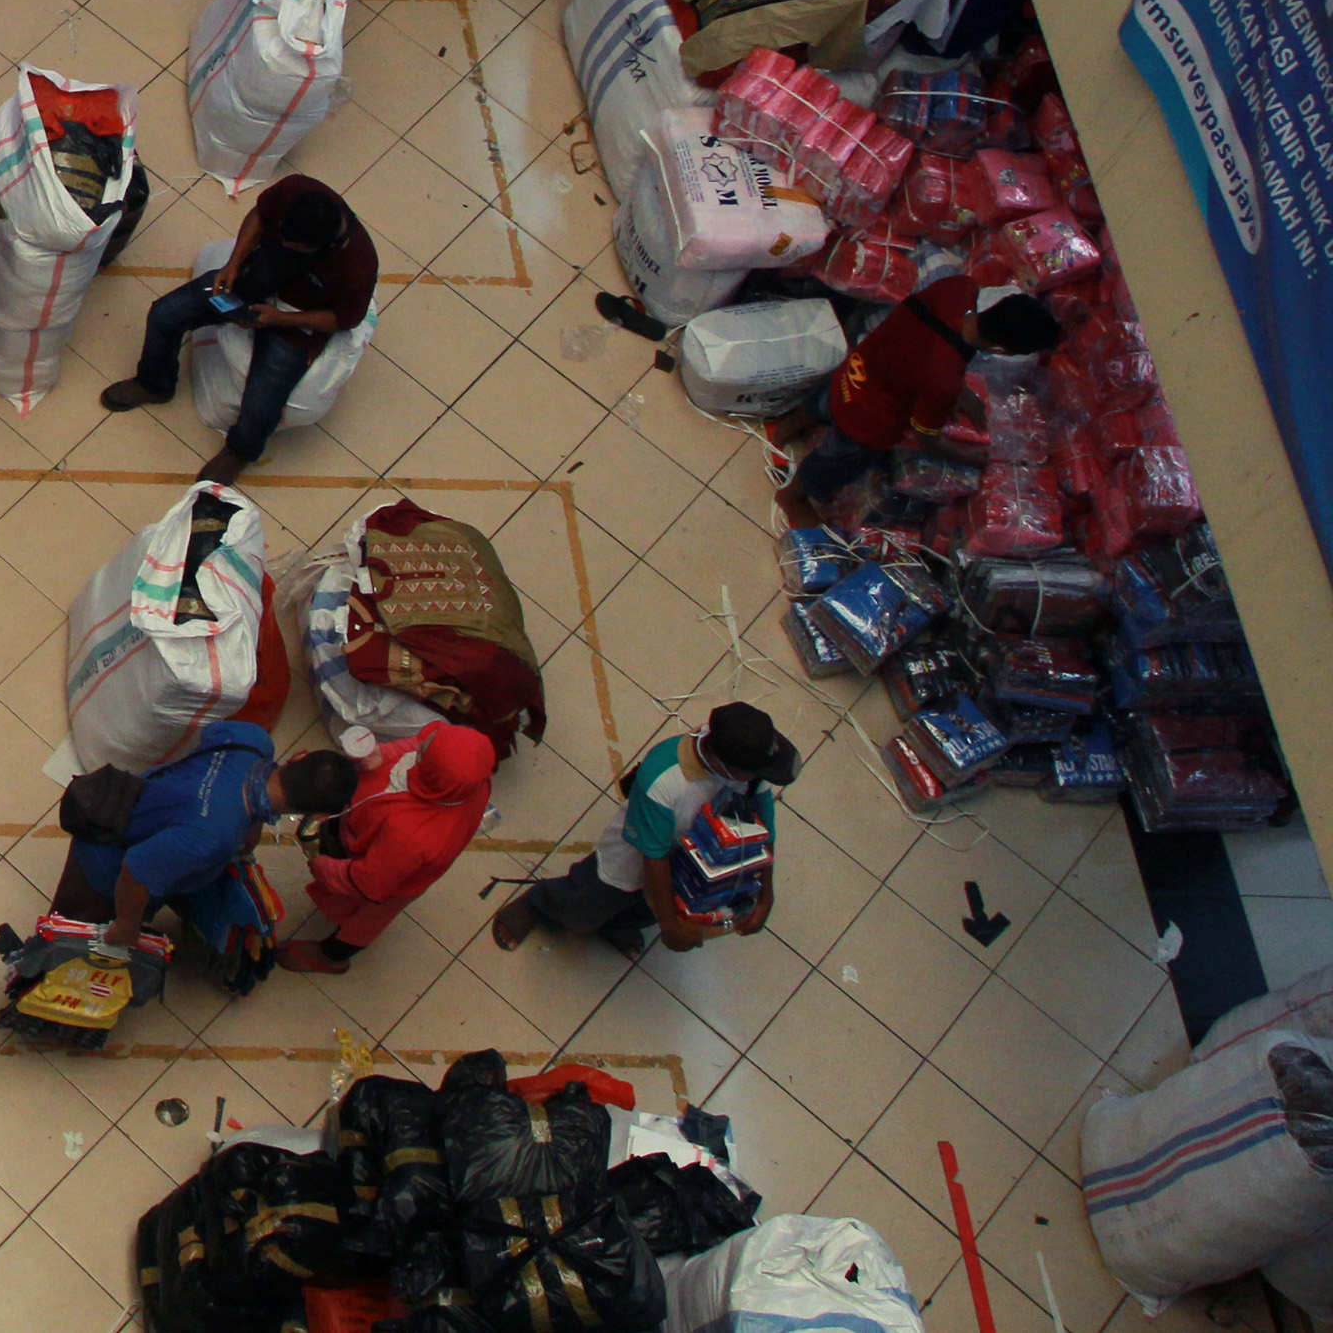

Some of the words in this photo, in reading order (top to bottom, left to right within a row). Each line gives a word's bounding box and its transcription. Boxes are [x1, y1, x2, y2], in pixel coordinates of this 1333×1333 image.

[1231, 63, 1262, 123] LINK
[1290, 230, 1317, 267] INI
[1298, 172, 1333, 235] UNIK
[90, 971, 123, 986] FLY
